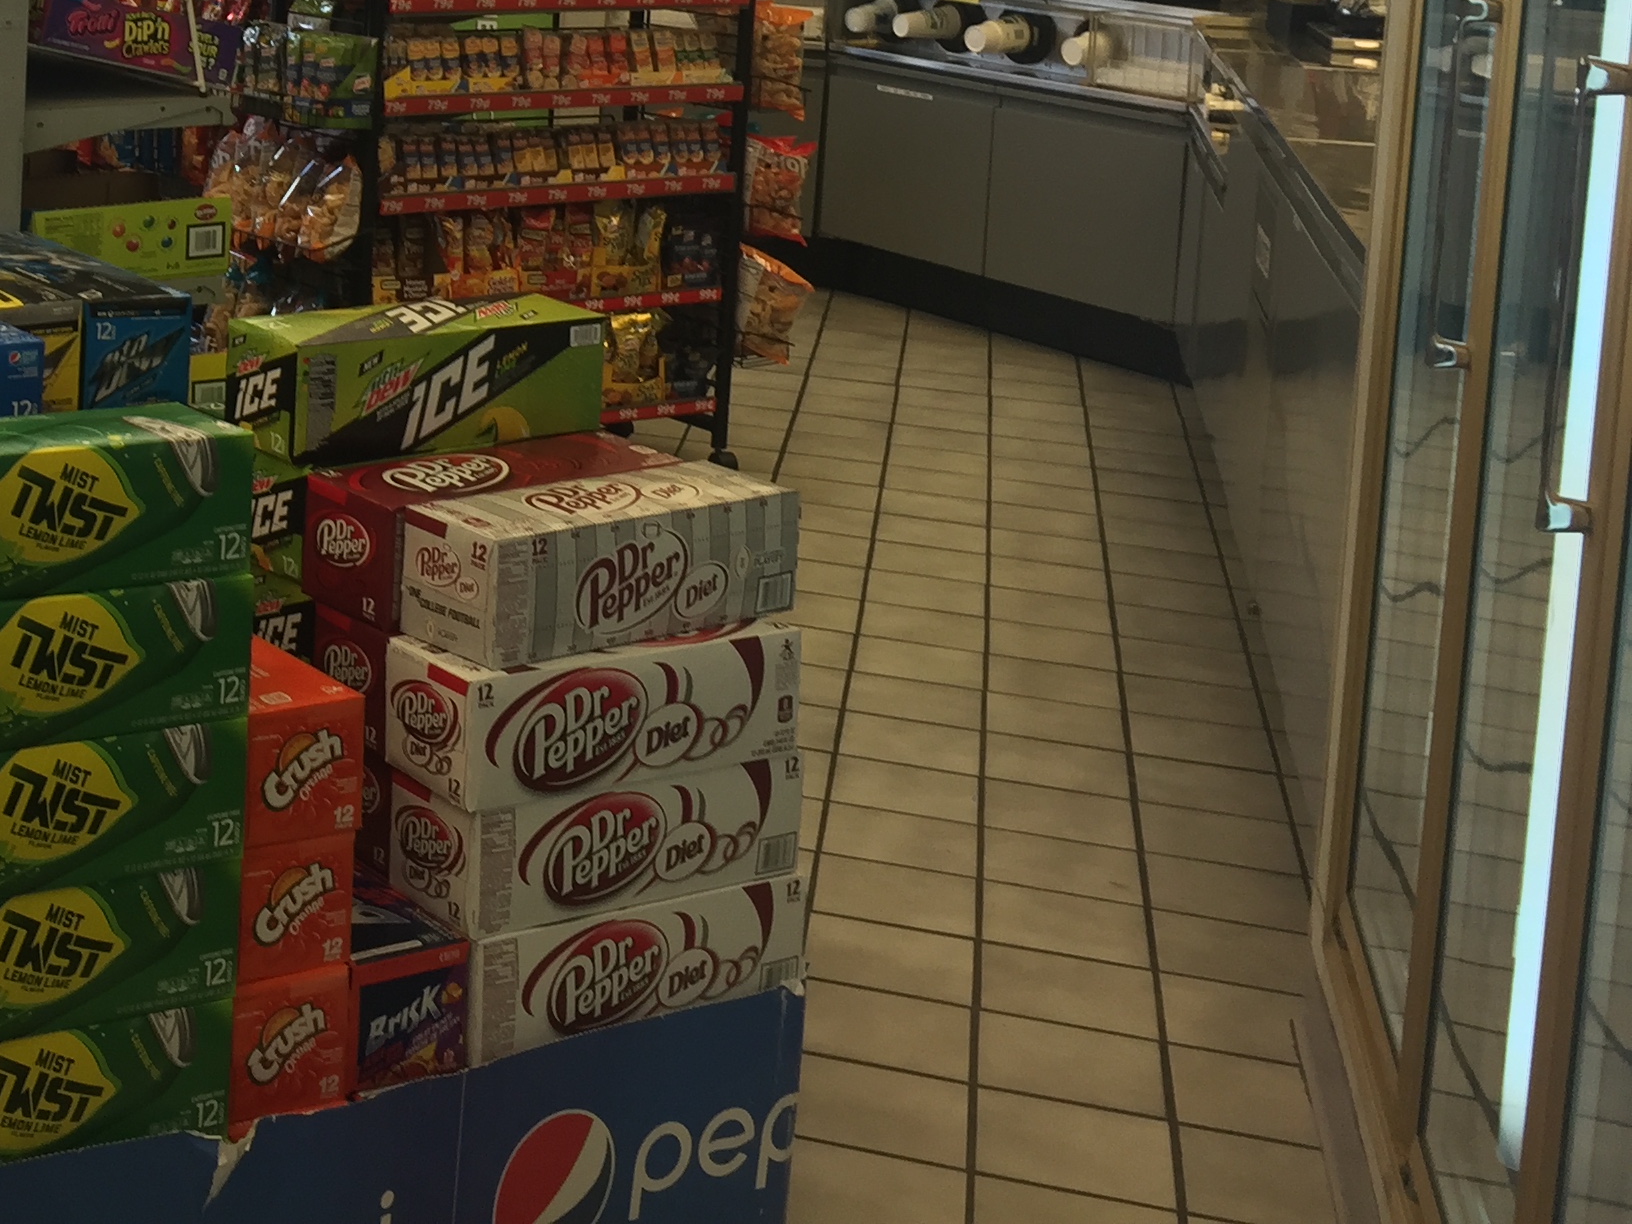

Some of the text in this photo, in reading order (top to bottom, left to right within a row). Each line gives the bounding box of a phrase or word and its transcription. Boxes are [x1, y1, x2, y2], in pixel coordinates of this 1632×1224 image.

[234, 368, 282, 419] ICE
[401, 333, 496, 451] ICE
[60, 463, 99, 493] MIST
[384, 454, 498, 493] Pepper
[414, 452, 454, 480] Dr
[19, 522, 87, 550] LEMON LIME
[317, 518, 368, 560] Pepper
[336, 520, 355, 540] Dr
[418, 546, 459, 580] Pepper
[432, 545, 449, 565] Dr
[471, 541, 487, 562] 12
[531, 538, 548, 557] 12
[615, 540, 656, 577] Dr
[587, 548, 681, 630] Pepper
[684, 572, 719, 610] Diet
[60, 611, 99, 641] MIST
[19, 672, 87, 700] LEMON LIME
[417, 691, 436, 714] Dr
[477, 682, 495, 702] 12
[400, 691, 448, 733] Pepper
[564, 686, 611, 721] Dr
[532, 693, 640, 780] Pepper
[645, 716, 691, 757] Diet
[52, 757, 92, 787] MIST
[261, 726, 343, 810] Crush
[299, 760, 335, 802] Orange
[784, 755, 800, 774] 12
[11, 820, 79, 847] LEMON LIME
[407, 818, 452, 860] Pepper
[421, 817, 440, 839] Dr
[590, 807, 632, 841] Dr
[559, 815, 658, 897] Pepper
[667, 833, 706, 871] Diet
[253, 862, 335, 946] Crush
[785, 880, 801, 896] 12
[45, 903, 85, 932] MIST
[591, 934, 635, 968] Dr
[3, 967, 73, 991] LEMON LIME
[563, 942, 662, 1027] Pepper
[667, 958, 708, 1000] Diet
[247, 1001, 328, 1084] Crush
[35, 1048, 75, 1077] MIST
[34, 1121, 62, 1136] LIME
[627, 1090, 798, 1220] pep
